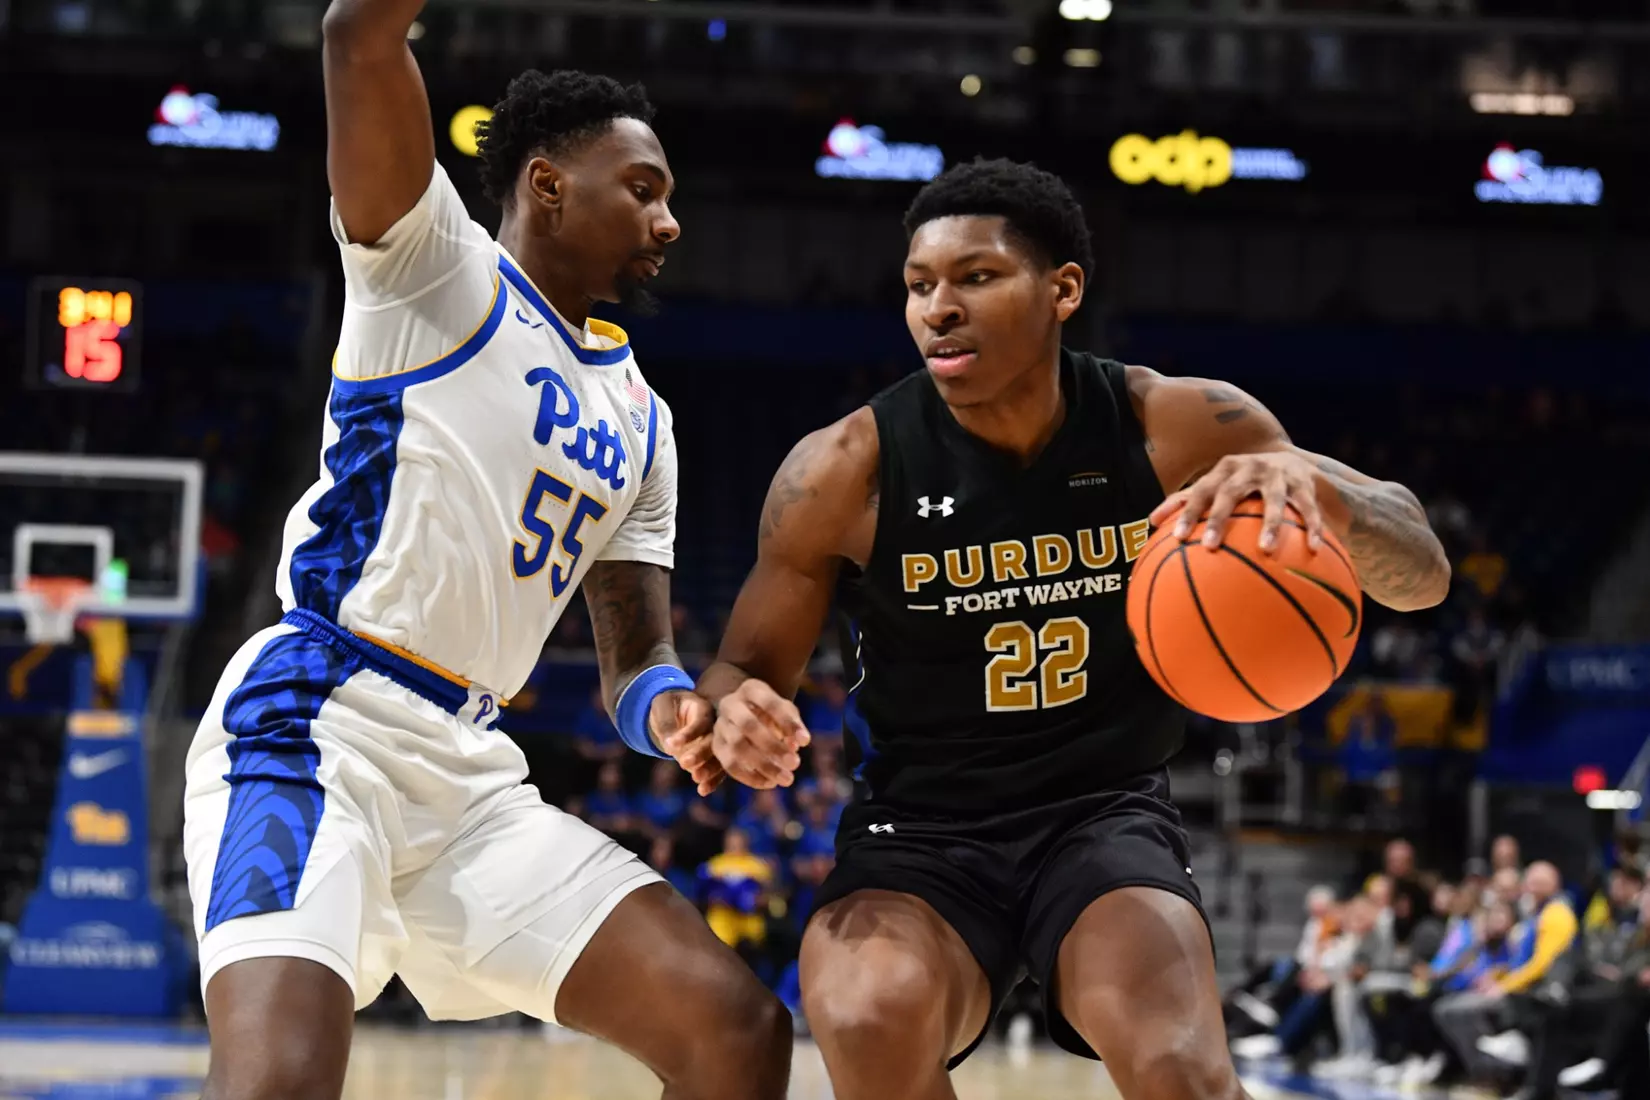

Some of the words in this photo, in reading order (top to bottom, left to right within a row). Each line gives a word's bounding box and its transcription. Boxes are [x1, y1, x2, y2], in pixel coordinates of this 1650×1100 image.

[64, 317, 122, 382] 15
[525, 367, 626, 490] Pitt
[1068, 477, 1108, 488] HORIZON
[510, 467, 610, 601] 55
[901, 517, 1151, 593] PURDUE
[945, 588, 1020, 615] FORT
[1023, 573, 1121, 606] WAYNE
[984, 616, 1090, 712] 22
